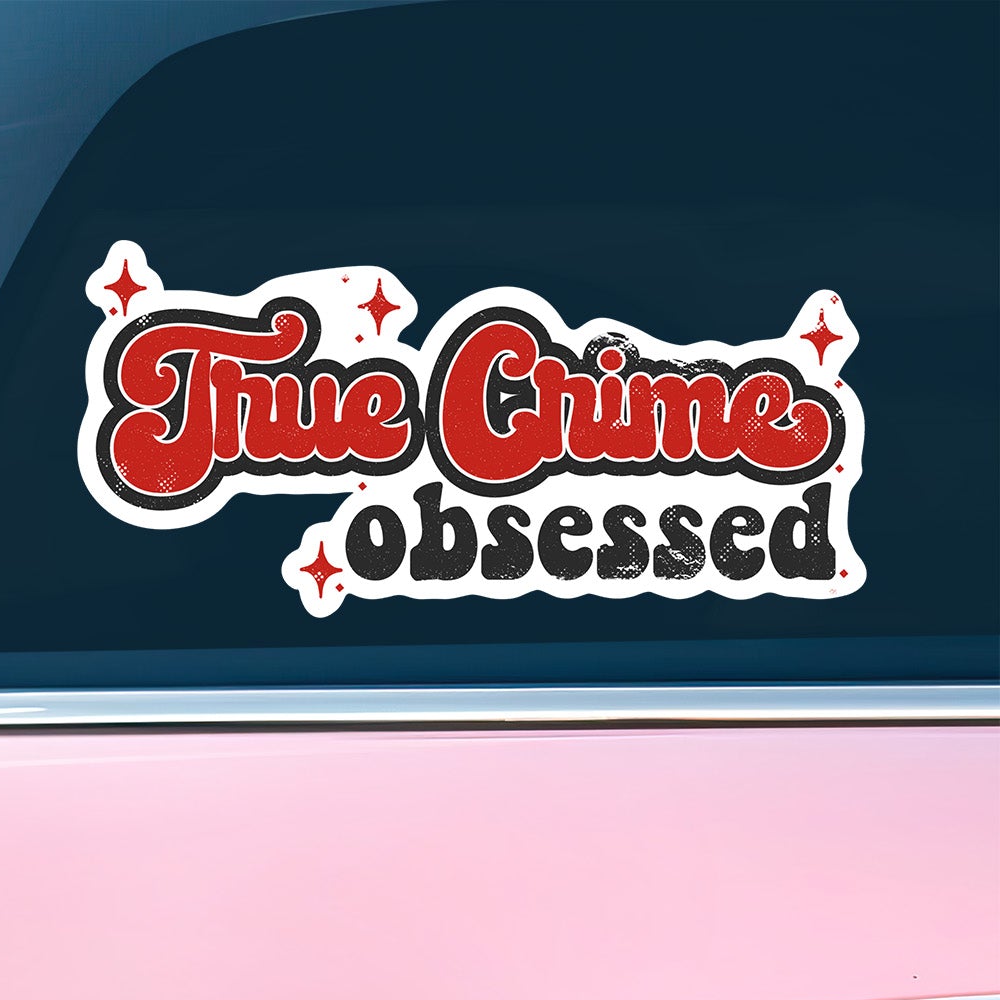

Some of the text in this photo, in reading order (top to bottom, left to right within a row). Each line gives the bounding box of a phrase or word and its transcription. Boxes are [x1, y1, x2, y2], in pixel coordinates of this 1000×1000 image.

[110, 309, 832, 495] True Crime
[345, 482, 836, 581] obsessed
